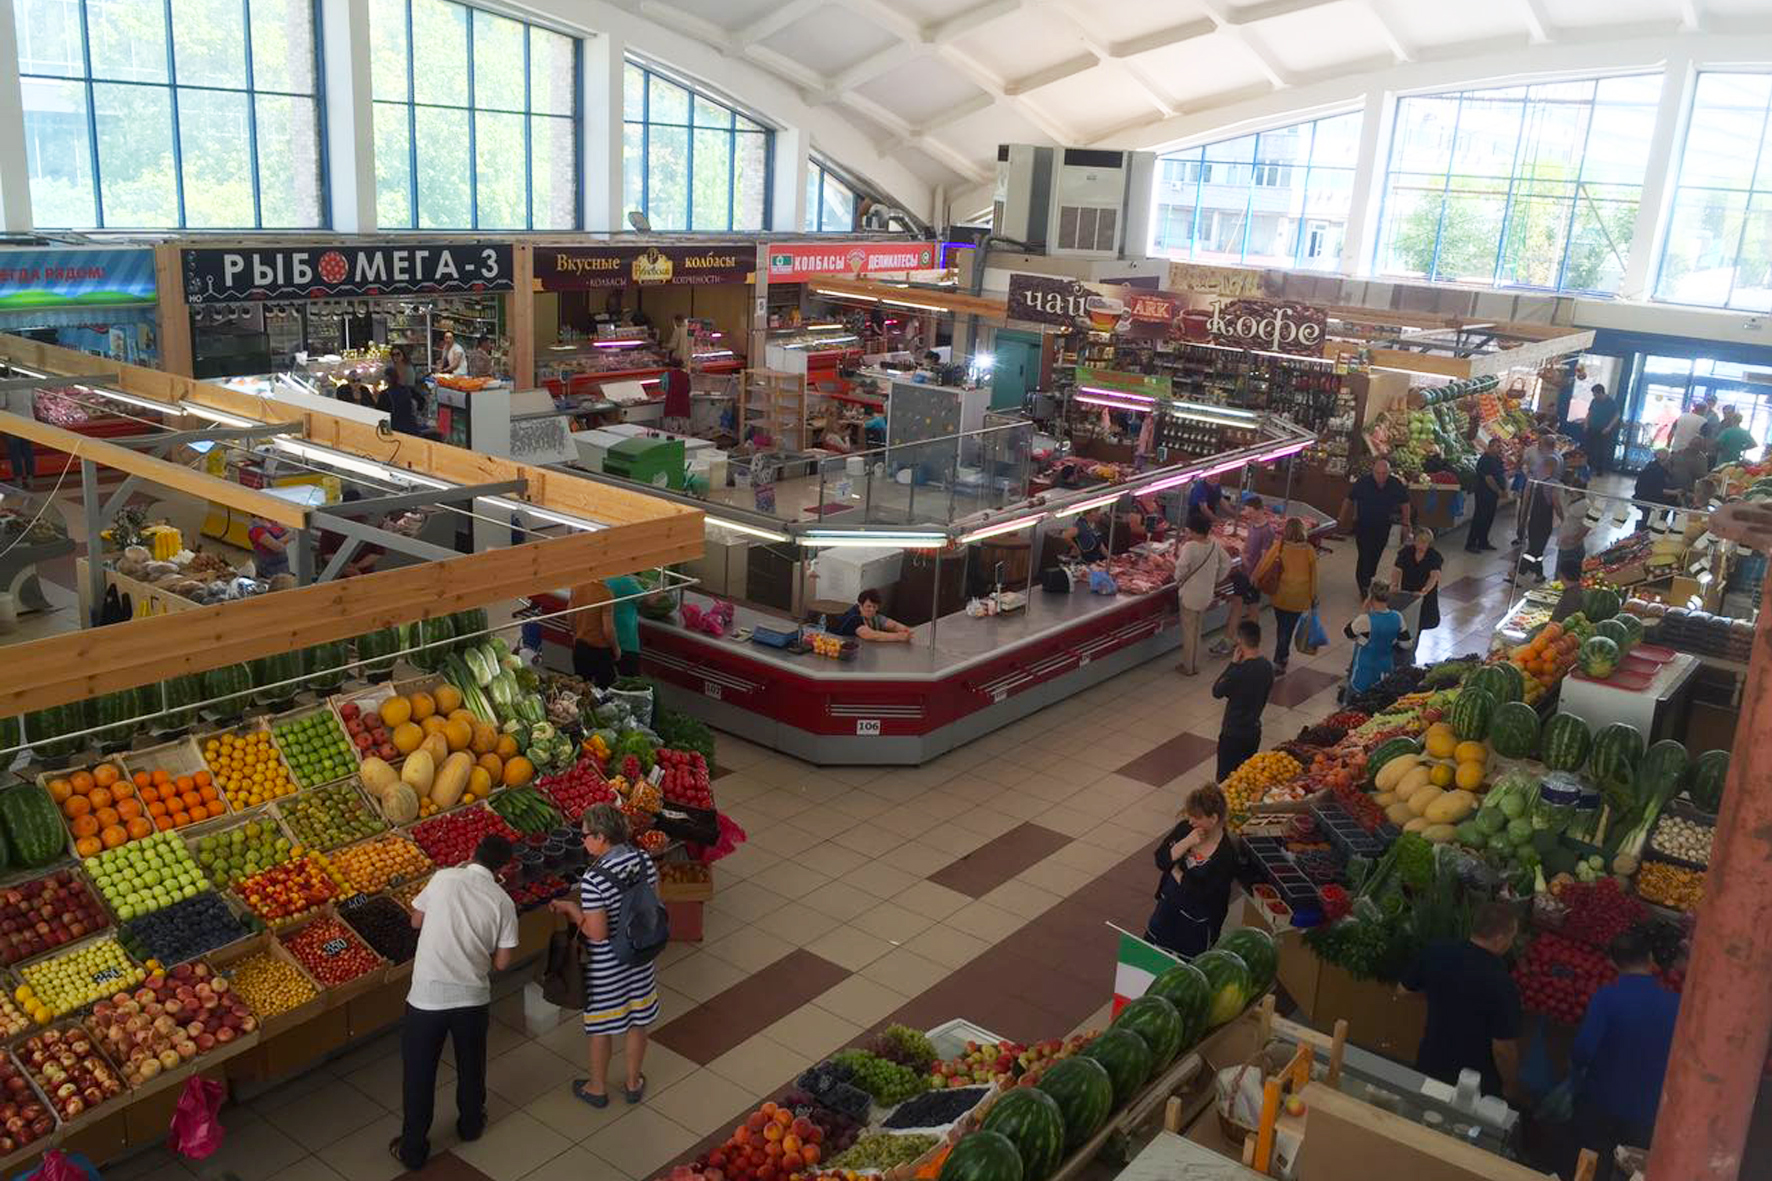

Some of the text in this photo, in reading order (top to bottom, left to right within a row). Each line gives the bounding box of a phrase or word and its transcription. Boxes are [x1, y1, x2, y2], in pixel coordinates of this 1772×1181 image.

[556, 254, 621, 276] Вкусные
[685, 251, 736, 268] колбасы
[794, 255, 845, 271] КОЛБАСЫ
[868, 253, 918, 270] ДЕЛИКАТЕСЫ
[1024, 281, 1320, 351] чай кофе
[859, 721, 879, 731] 106
[323, 938, 348, 955] 350
